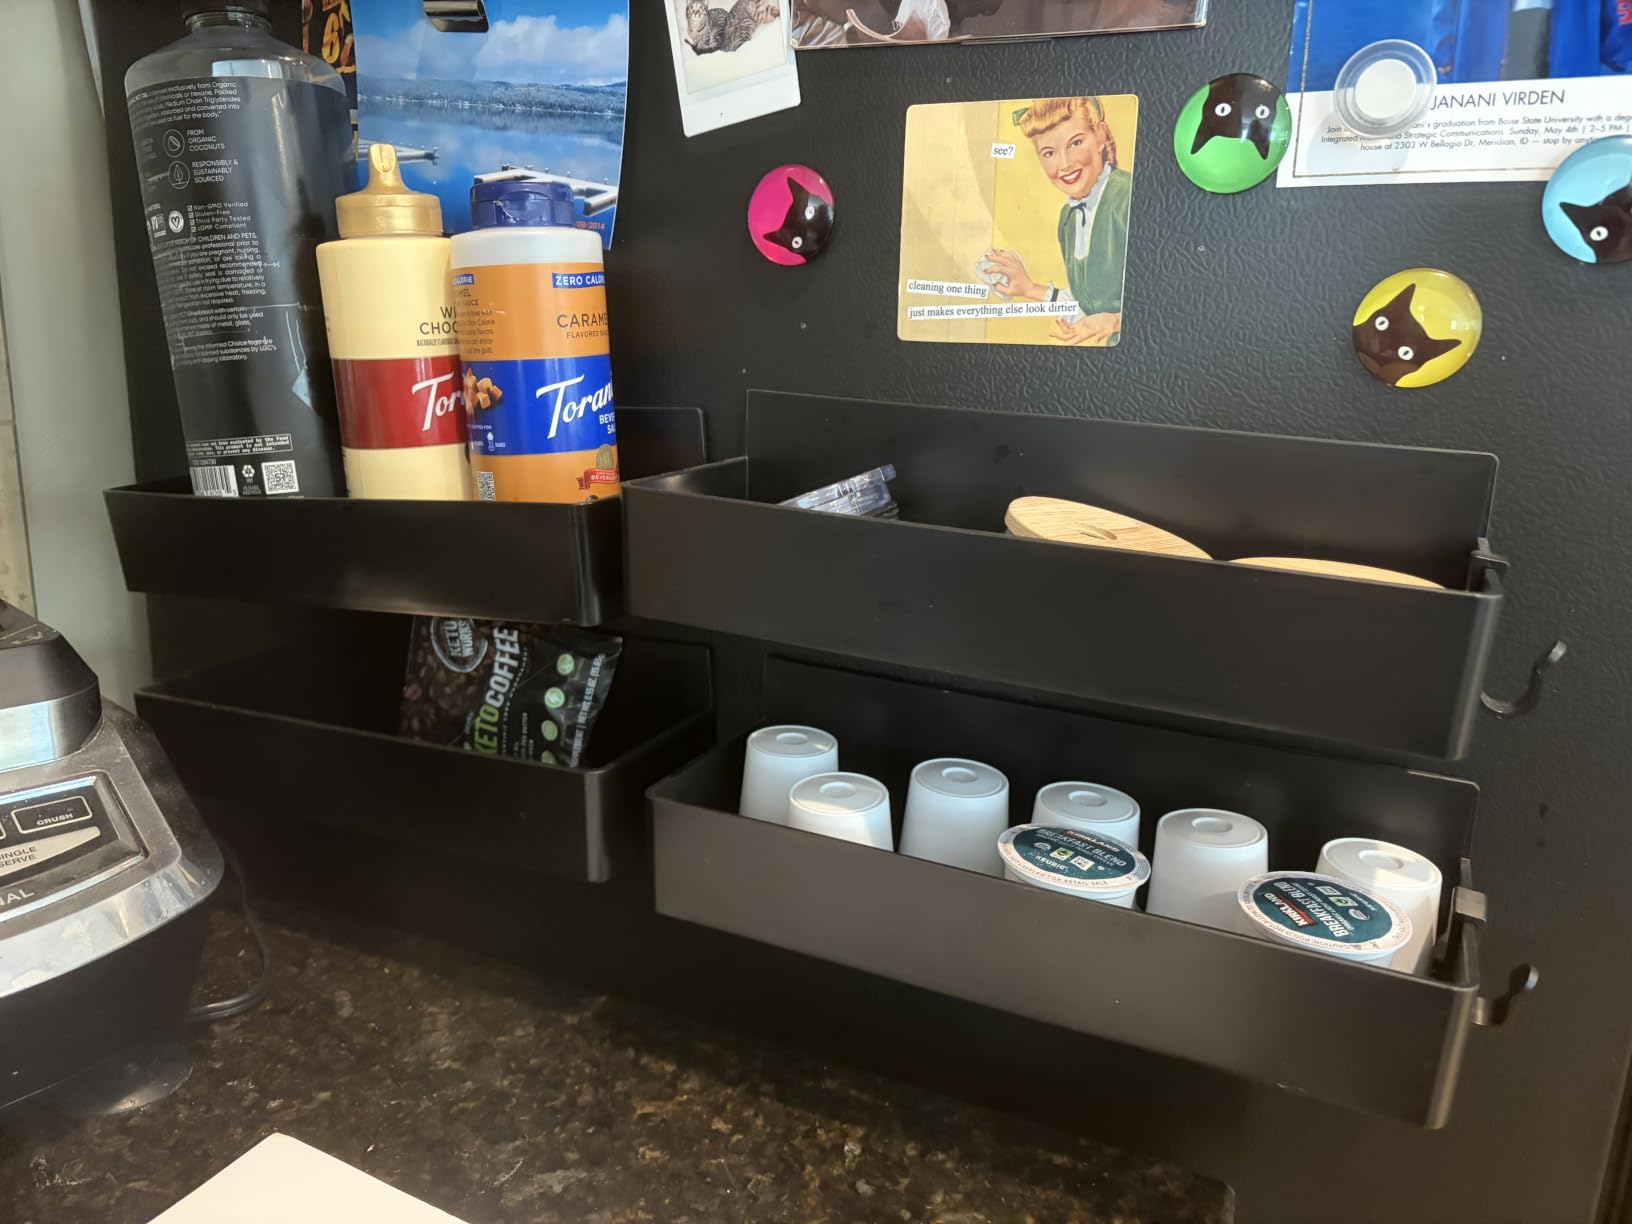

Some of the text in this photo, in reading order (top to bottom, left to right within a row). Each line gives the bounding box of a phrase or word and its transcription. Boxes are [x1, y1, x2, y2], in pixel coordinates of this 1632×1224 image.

[1430, 89, 1566, 110] JANANI VIRDEN
[1433, 120, 1475, 129] graduation
[1521, 116, 1541, 124] State
[1544, 116, 1584, 124] University
[1321, 136, 1358, 145] Integrated
[1404, 131, 1437, 140] Strategic
[1509, 126, 1540, 135] Sunday,
[1544, 127, 1562, 135] May
[189, 143, 225, 151] COCONUTS
[1430, 140, 1462, 149] Bellagio
[1478, 138, 1517, 146] Meridian,
[1562, 136, 1572, 145] by
[993, 146, 1014, 156] see?
[194, 168, 232, 176] SUSTAINABLY
[195, 175, 224, 183] SOURCED
[198, 234, 226, 242] CHILDREN
[555, 276, 583, 286] ZERO
[908, 281, 988, 297] cleaning one thing
[909, 303, 1077, 319] just makes everything else look dirtier
[567, 331, 599, 339] FLAVORED
[36, 812, 73, 826] CRUSH
[1036, 828, 1094, 851] BREAKFAST
[1092, 848, 1127, 866] BLEND
[0, 854, 37, 867] SERVE
[1034, 855, 1068, 870] KEURIG
[1272, 881, 1306, 897] BLEND
[1261, 892, 1309, 925] KIRKLAND
[1296, 897, 1349, 936] BREAKFAST
